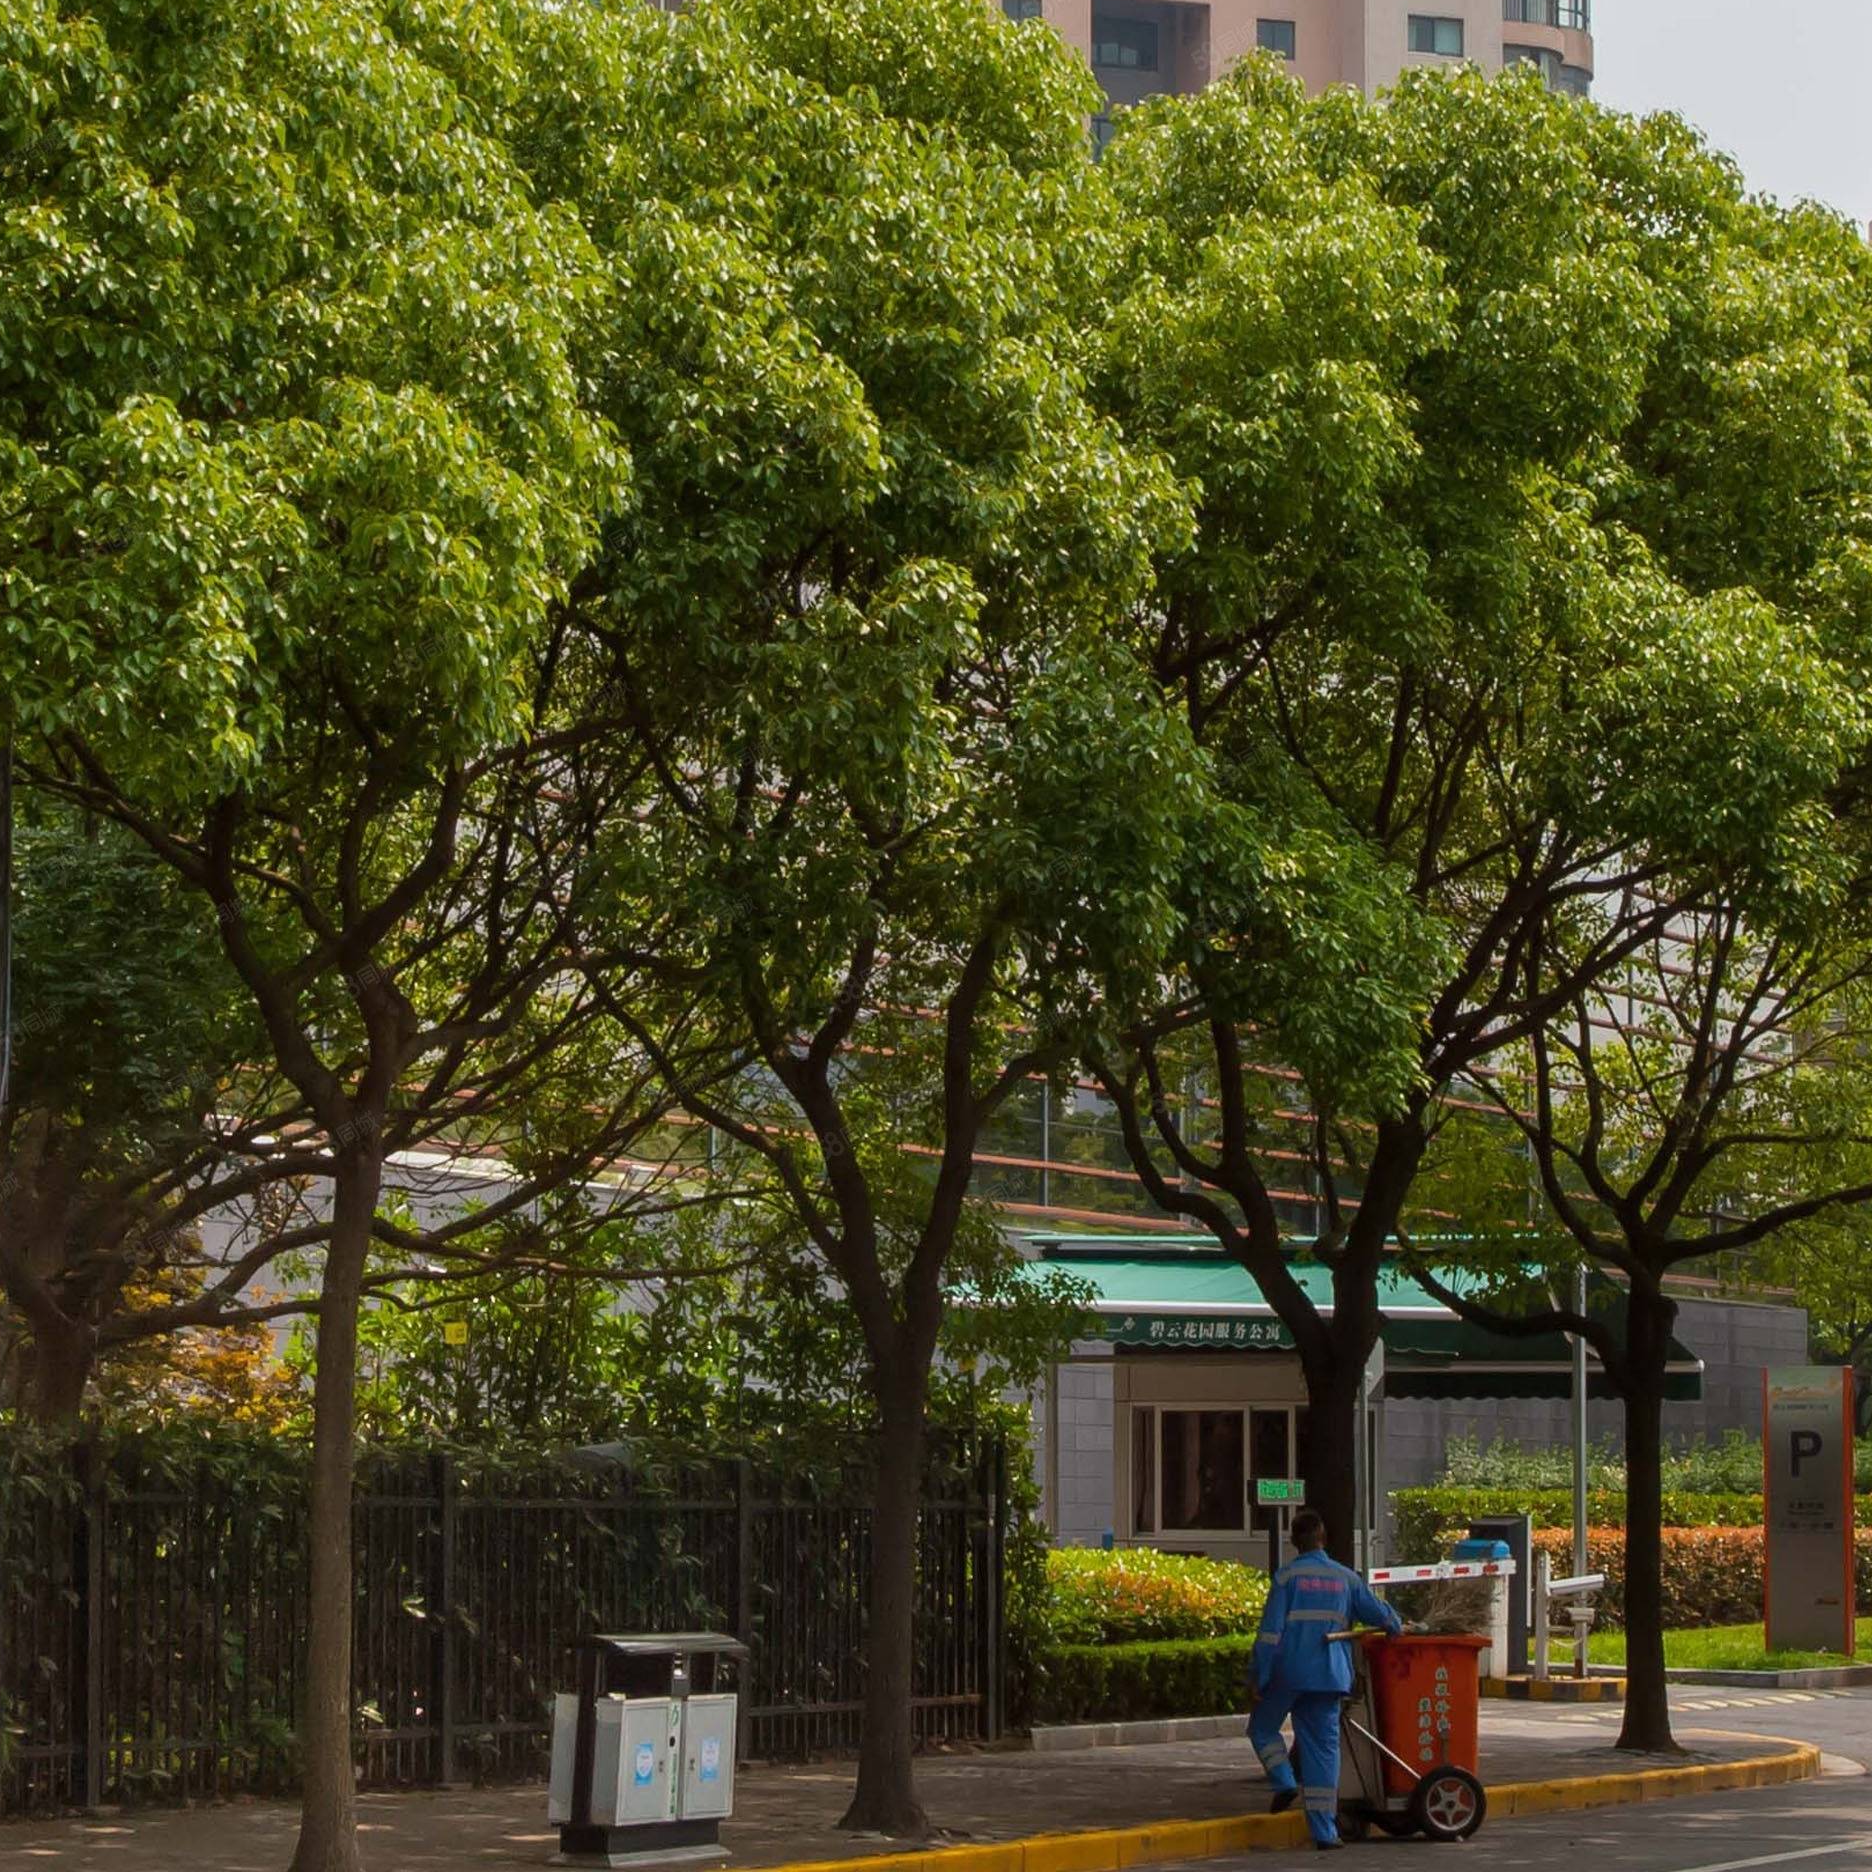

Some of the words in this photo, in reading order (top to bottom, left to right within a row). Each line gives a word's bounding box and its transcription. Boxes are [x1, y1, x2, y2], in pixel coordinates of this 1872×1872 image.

[1150, 1319, 1281, 1340] 碧云花园服务公寓
[1790, 1430, 1823, 1478] P
